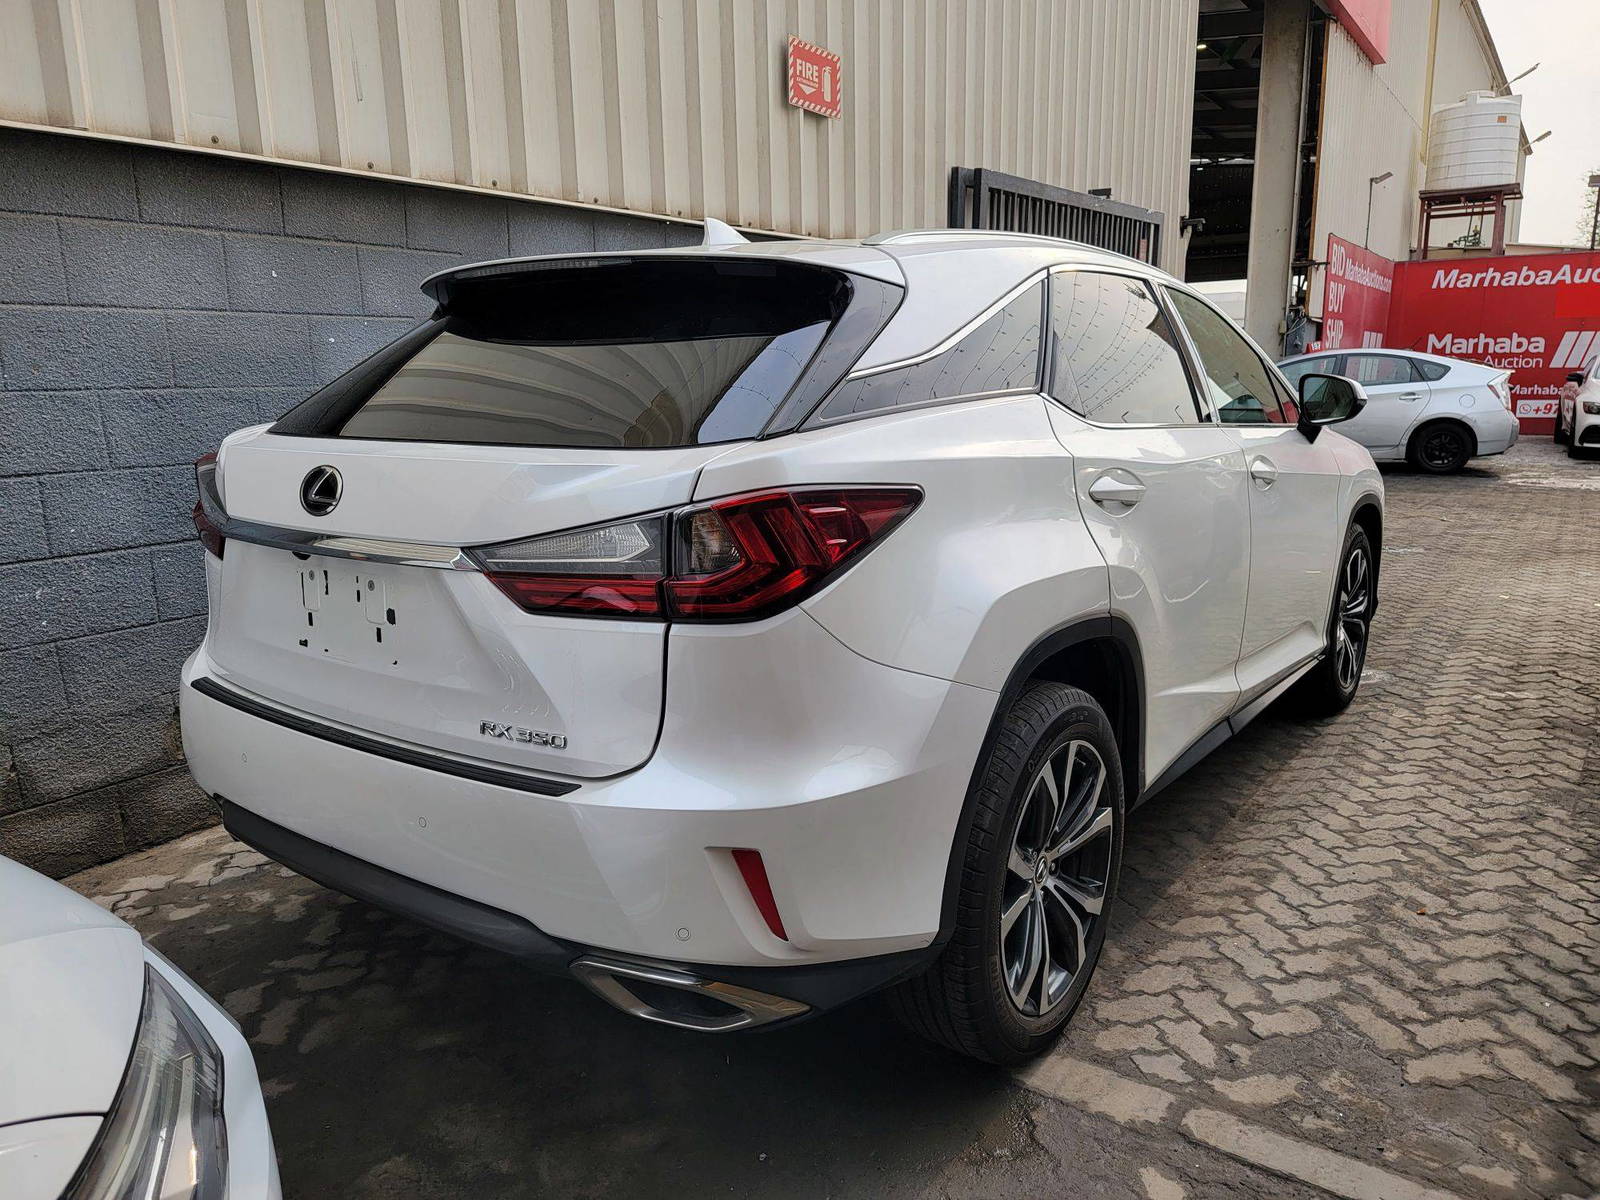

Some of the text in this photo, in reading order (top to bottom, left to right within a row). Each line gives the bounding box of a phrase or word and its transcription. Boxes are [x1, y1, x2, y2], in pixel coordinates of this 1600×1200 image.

[796, 58, 819, 82] FIRE
[1331, 243, 1346, 277] BID
[1328, 281, 1346, 313] BUY
[1325, 318, 1344, 348] SHIP
[1426, 332, 1546, 354] Marhaba
[1484, 355, 1543, 369] Auction
[480, 720, 568, 750] RX 350
